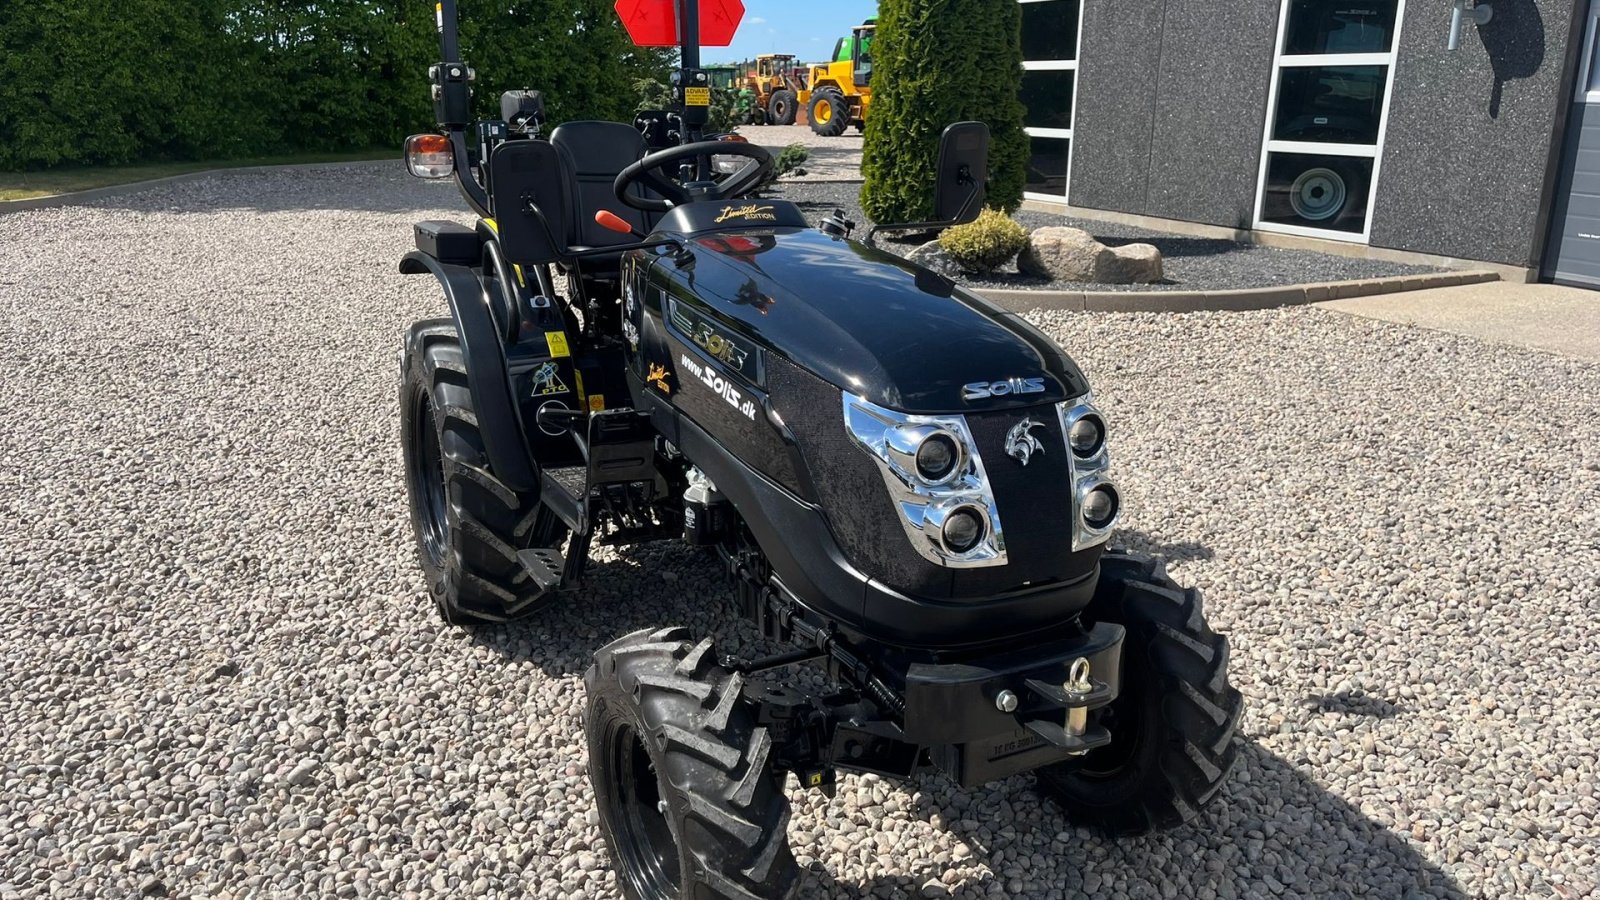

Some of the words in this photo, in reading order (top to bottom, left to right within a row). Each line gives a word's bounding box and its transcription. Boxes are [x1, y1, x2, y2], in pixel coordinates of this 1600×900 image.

[714, 204, 774, 223] Limited
[745, 212, 777, 221] EDITION
[541, 384, 568, 395] PTO
